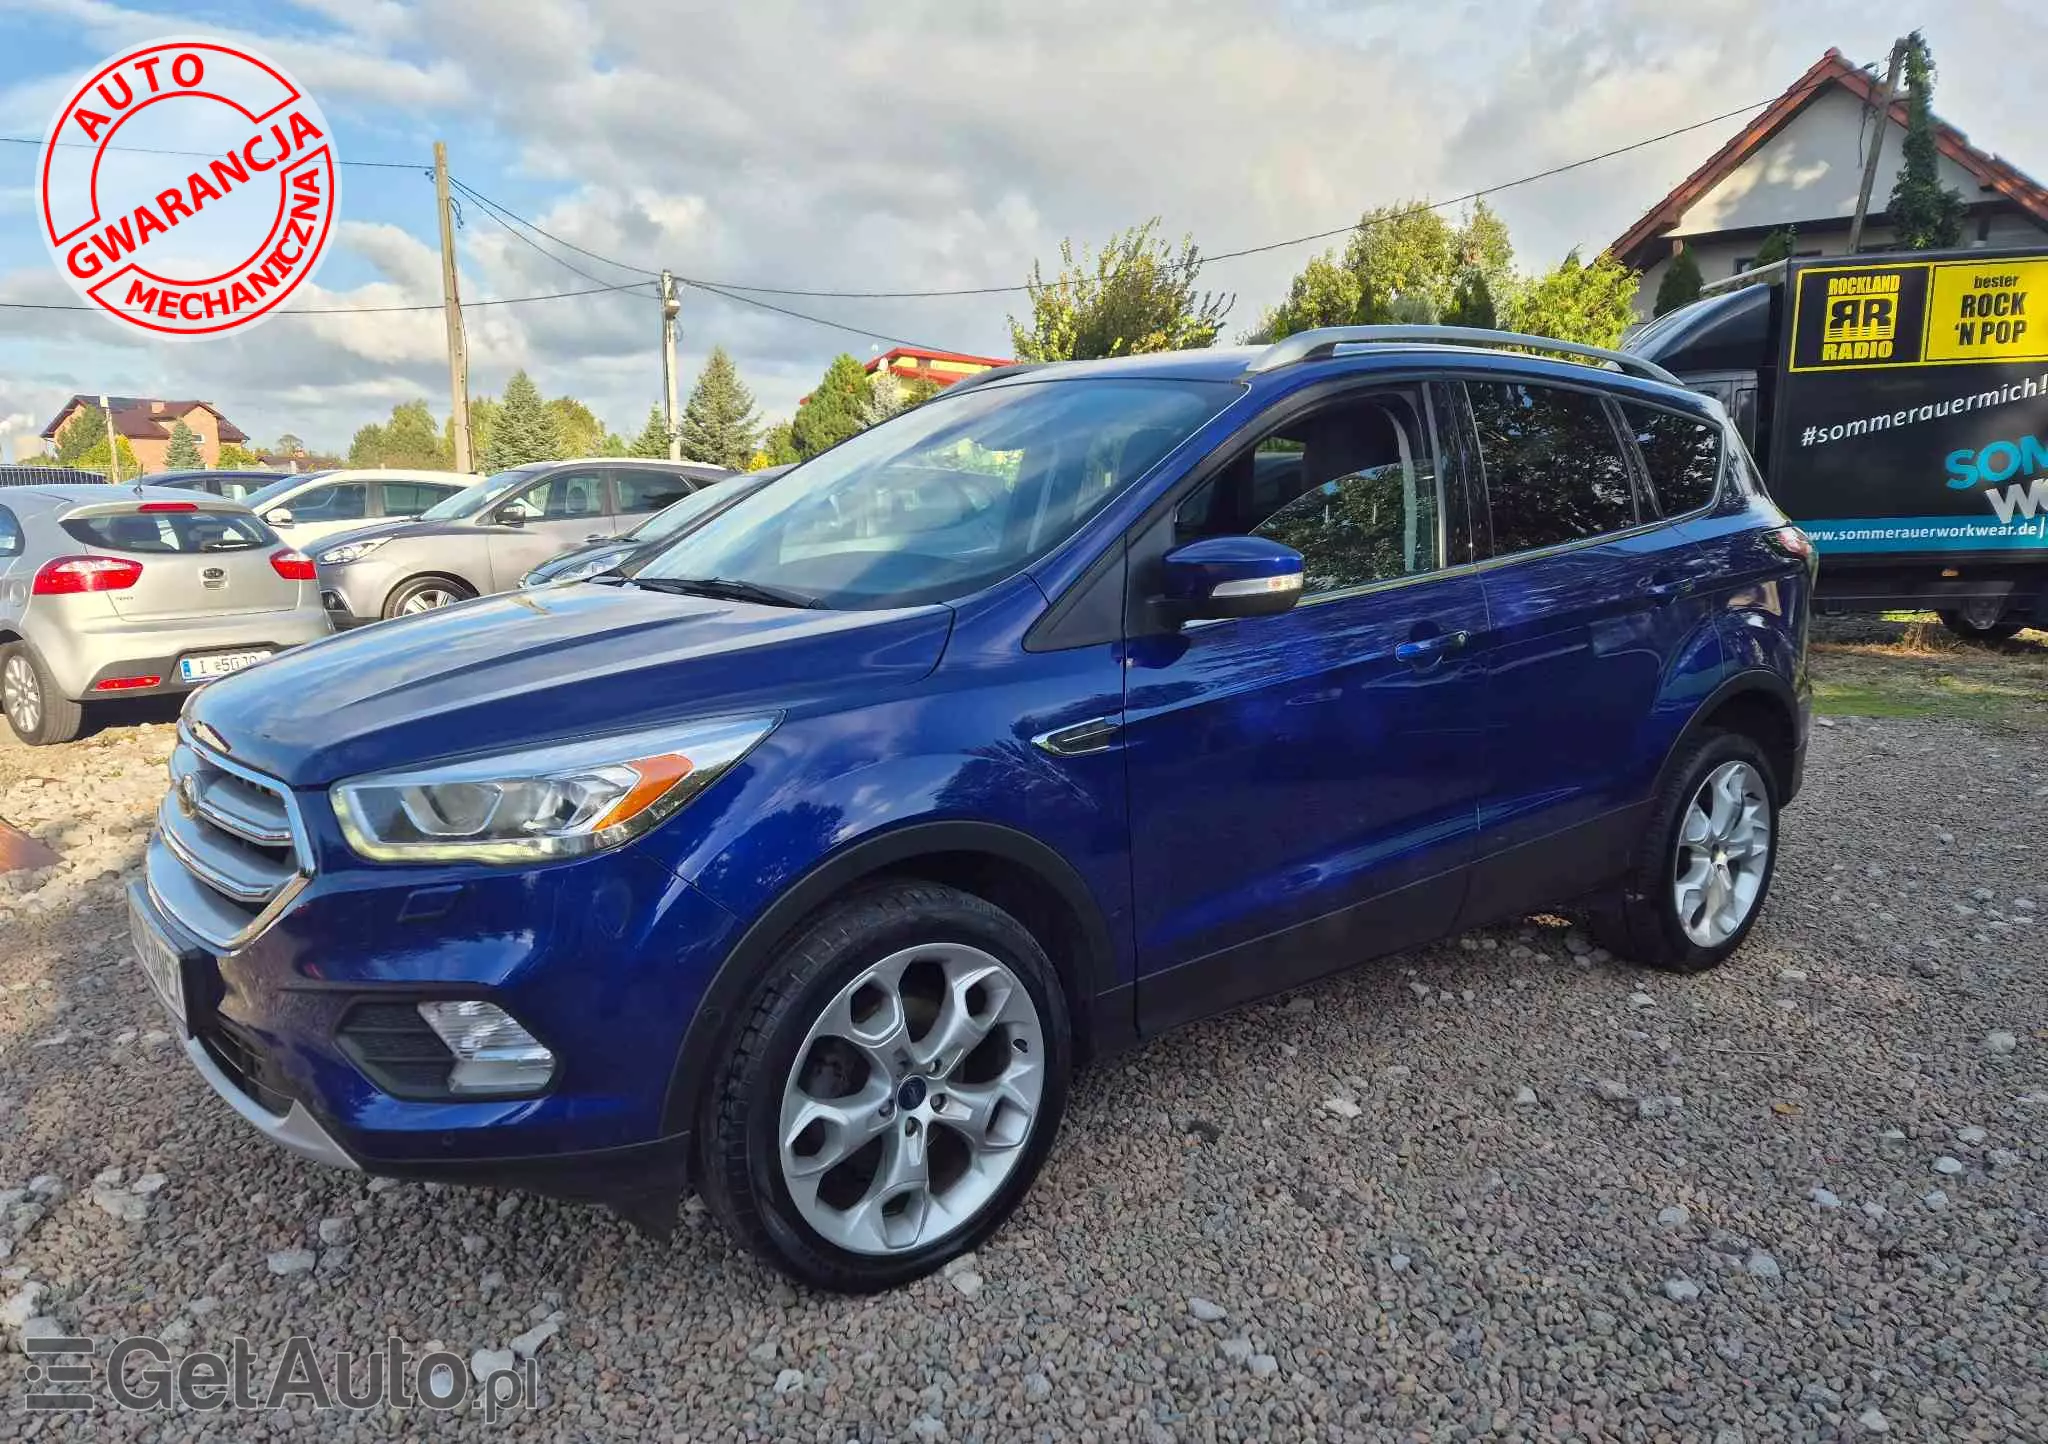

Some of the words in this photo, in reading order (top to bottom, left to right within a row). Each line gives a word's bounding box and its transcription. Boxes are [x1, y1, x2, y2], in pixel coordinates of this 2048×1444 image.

[1828, 275, 1901, 296] ROCKLAND
[1974, 275, 2020, 288] bester
[1961, 292, 2028, 318] ROCK
[1980, 320, 2027, 345] POP
[1822, 340, 1893, 361] RADIO
[1801, 373, 2048, 447] #sommerauermich!
